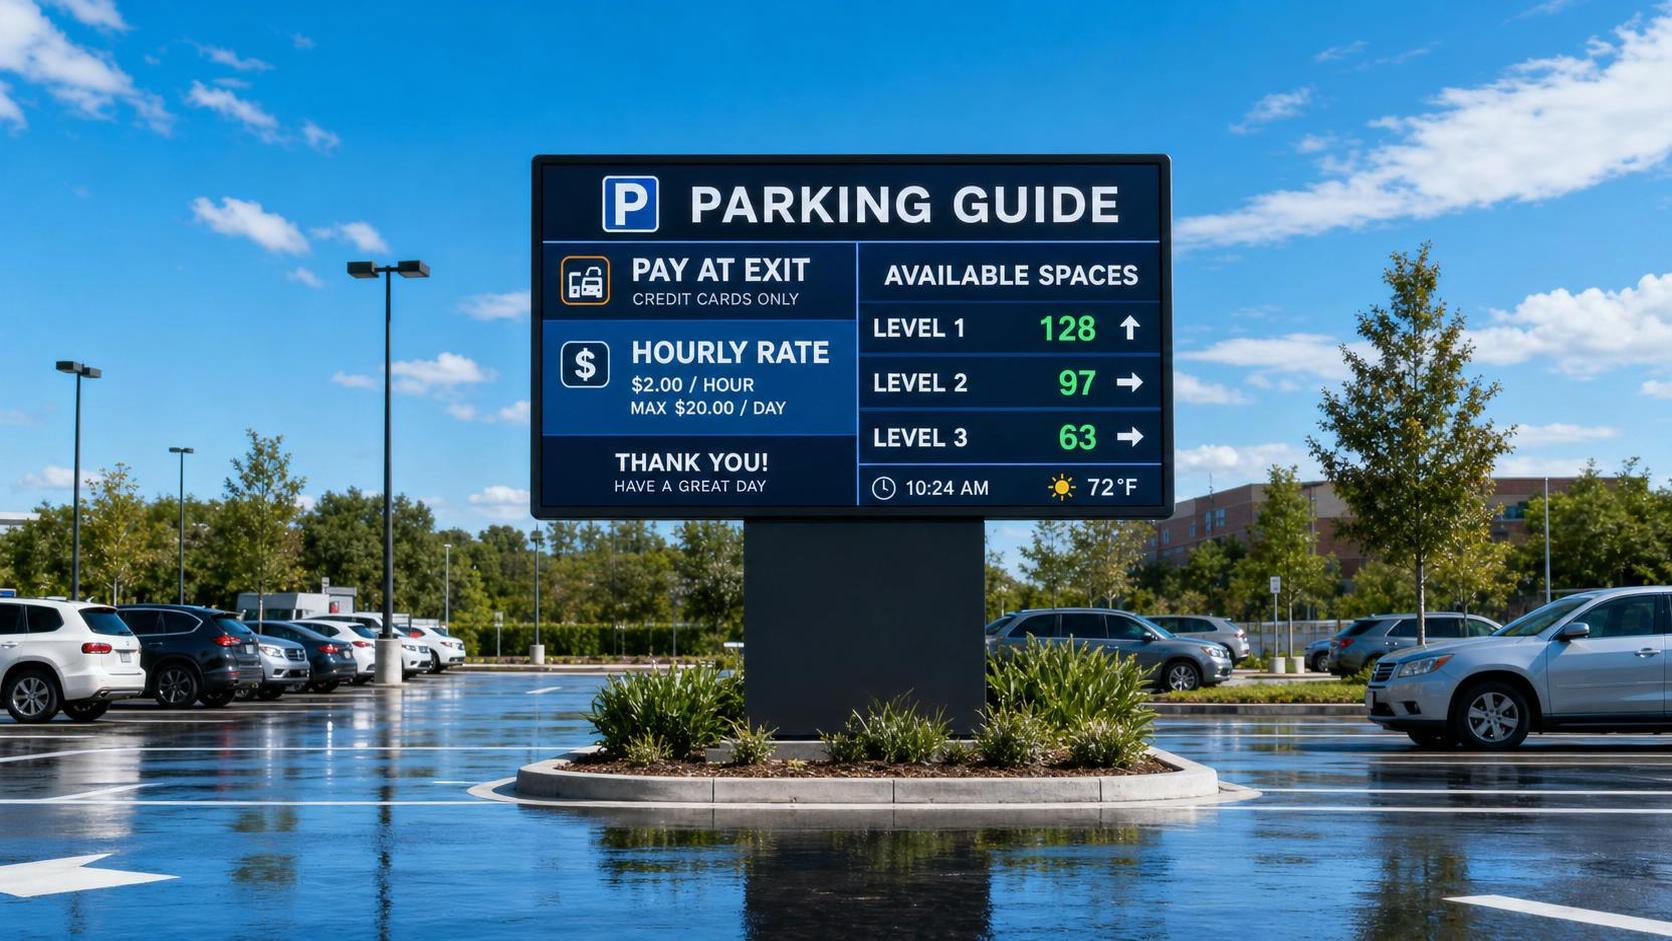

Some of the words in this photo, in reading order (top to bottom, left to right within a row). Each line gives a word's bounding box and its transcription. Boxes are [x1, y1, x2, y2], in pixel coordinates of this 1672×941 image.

[615, 183, 647, 225] P
[692, 186, 930, 223] PARKING
[954, 186, 1118, 223] GUIDE
[633, 258, 689, 281] PAY
[697, 258, 735, 281] AT
[745, 258, 810, 281] EXIT
[885, 265, 1029, 285] AVAILABLE
[1039, 265, 1138, 285] SPACES
[633, 293, 691, 305] CREDIT
[697, 293, 751, 305] CARDS
[758, 293, 798, 305] ONLY
[874, 318, 945, 337] LEVEL
[955, 318, 963, 337] 1
[1041, 315, 1095, 341] 128
[633, 341, 748, 364] HOURLY
[758, 341, 829, 363] RATE
[575, 348, 596, 381] $
[632, 376, 682, 394] $2.00
[689, 376, 697, 393] /
[704, 378, 753, 392] HOUR
[874, 373, 946, 392] LEVEL
[955, 373, 967, 392] 2
[1060, 370, 1095, 395] 97
[631, 401, 666, 414] MAX
[675, 399, 734, 416] $20.00
[740, 400, 747, 416] /
[754, 401, 786, 414] DAY
[874, 428, 946, 447] LEVEL
[954, 428, 967, 447] 3
[1060, 424, 1096, 450] 63
[615, 453, 700, 471] THANK
[709, 453, 767, 472] YOU!
[615, 480, 654, 492] HAVE
[662, 480, 672, 491] A
[679, 480, 729, 492] GREAT
[737, 480, 766, 492] DAY
[907, 480, 954, 495] 10:24
[961, 480, 988, 495] AM
[1088, 479, 1137, 495] 72°F
